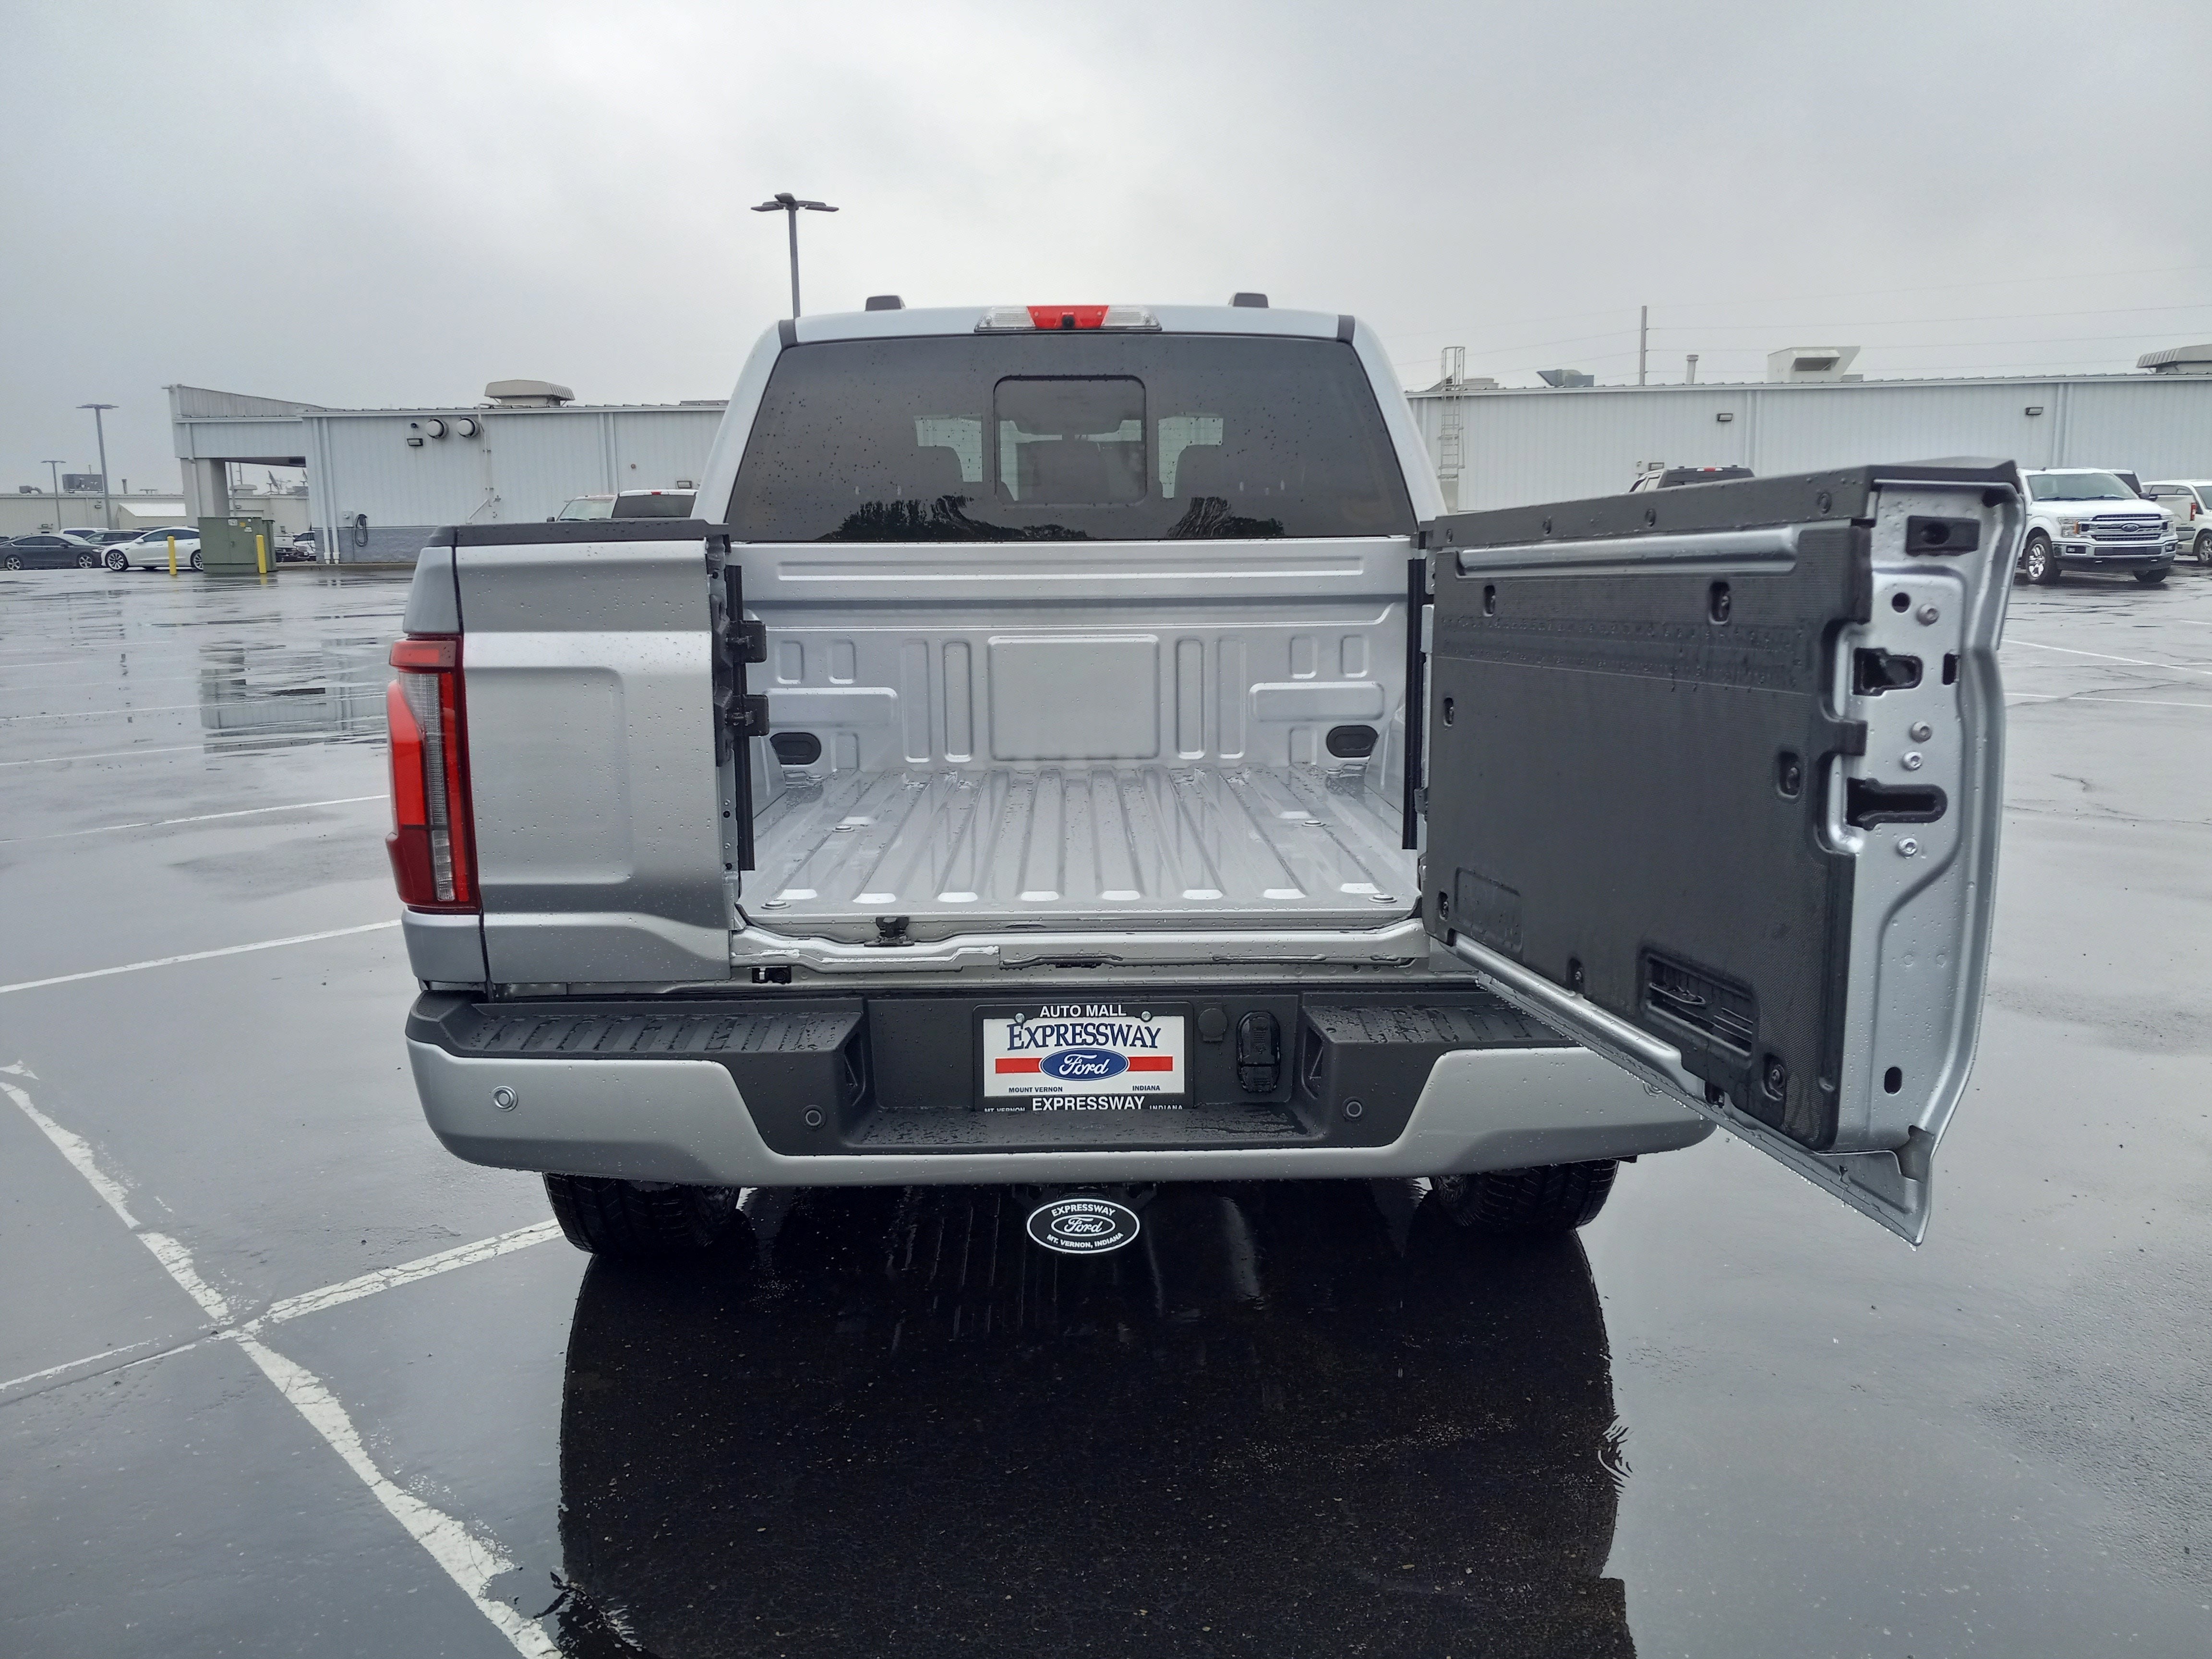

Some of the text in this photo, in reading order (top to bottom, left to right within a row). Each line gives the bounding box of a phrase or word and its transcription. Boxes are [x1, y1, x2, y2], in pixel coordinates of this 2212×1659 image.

[1040, 1004, 1127, 1018] AUTO MALL
[1007, 1022, 1161, 1051] EXPRESSWAY
[1058, 1054, 1110, 1075] Ford
[1033, 1096, 1145, 1111] EXPRESSWAY
[1051, 1204, 1116, 1217] EXPRESSWAY
[1064, 1217, 1103, 1233] Ford
[1046, 1232, 1124, 1248] MT. VERNON, INDIANA
